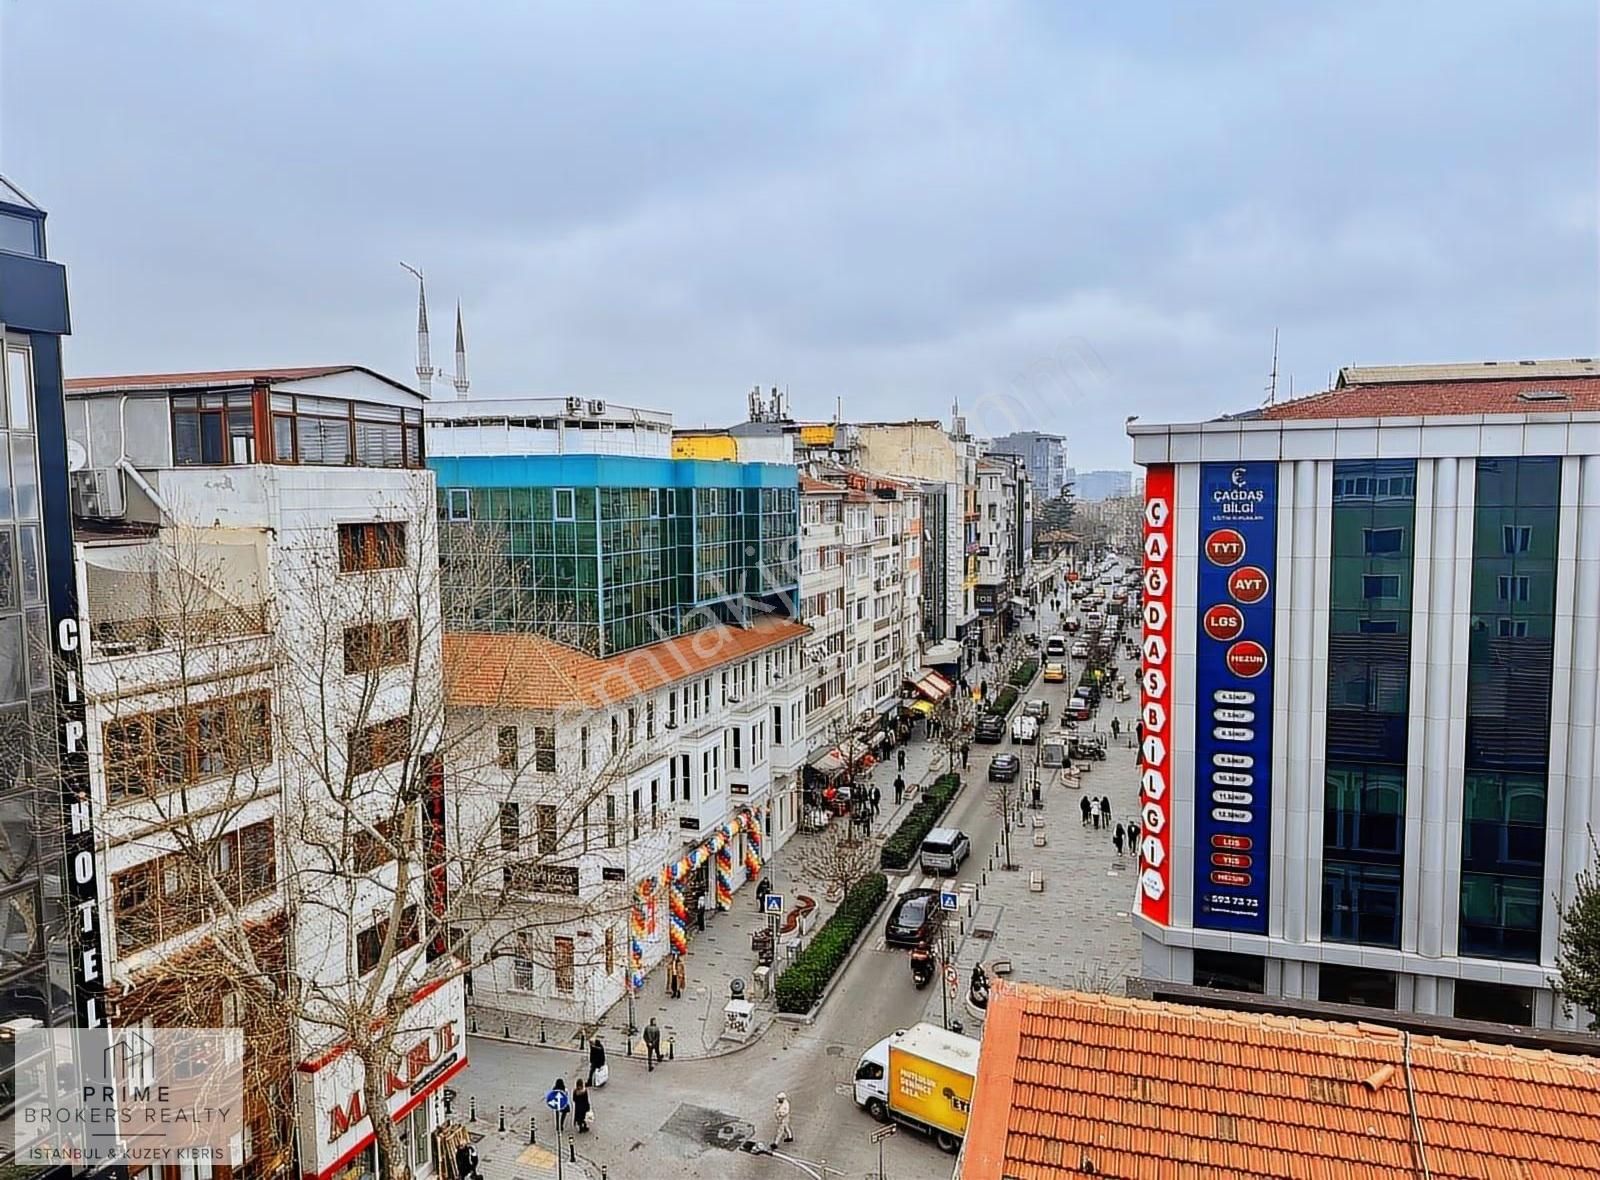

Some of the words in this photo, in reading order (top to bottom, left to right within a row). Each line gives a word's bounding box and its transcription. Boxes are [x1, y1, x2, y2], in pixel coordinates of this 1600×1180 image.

[1213, 490, 1264, 503] ÇAĞDAŞ
[1223, 501, 1254, 513] BİLGİ
[1212, 542, 1240, 554] TYT
[1235, 579, 1263, 590] AYT
[1210, 616, 1238, 627] LGS
